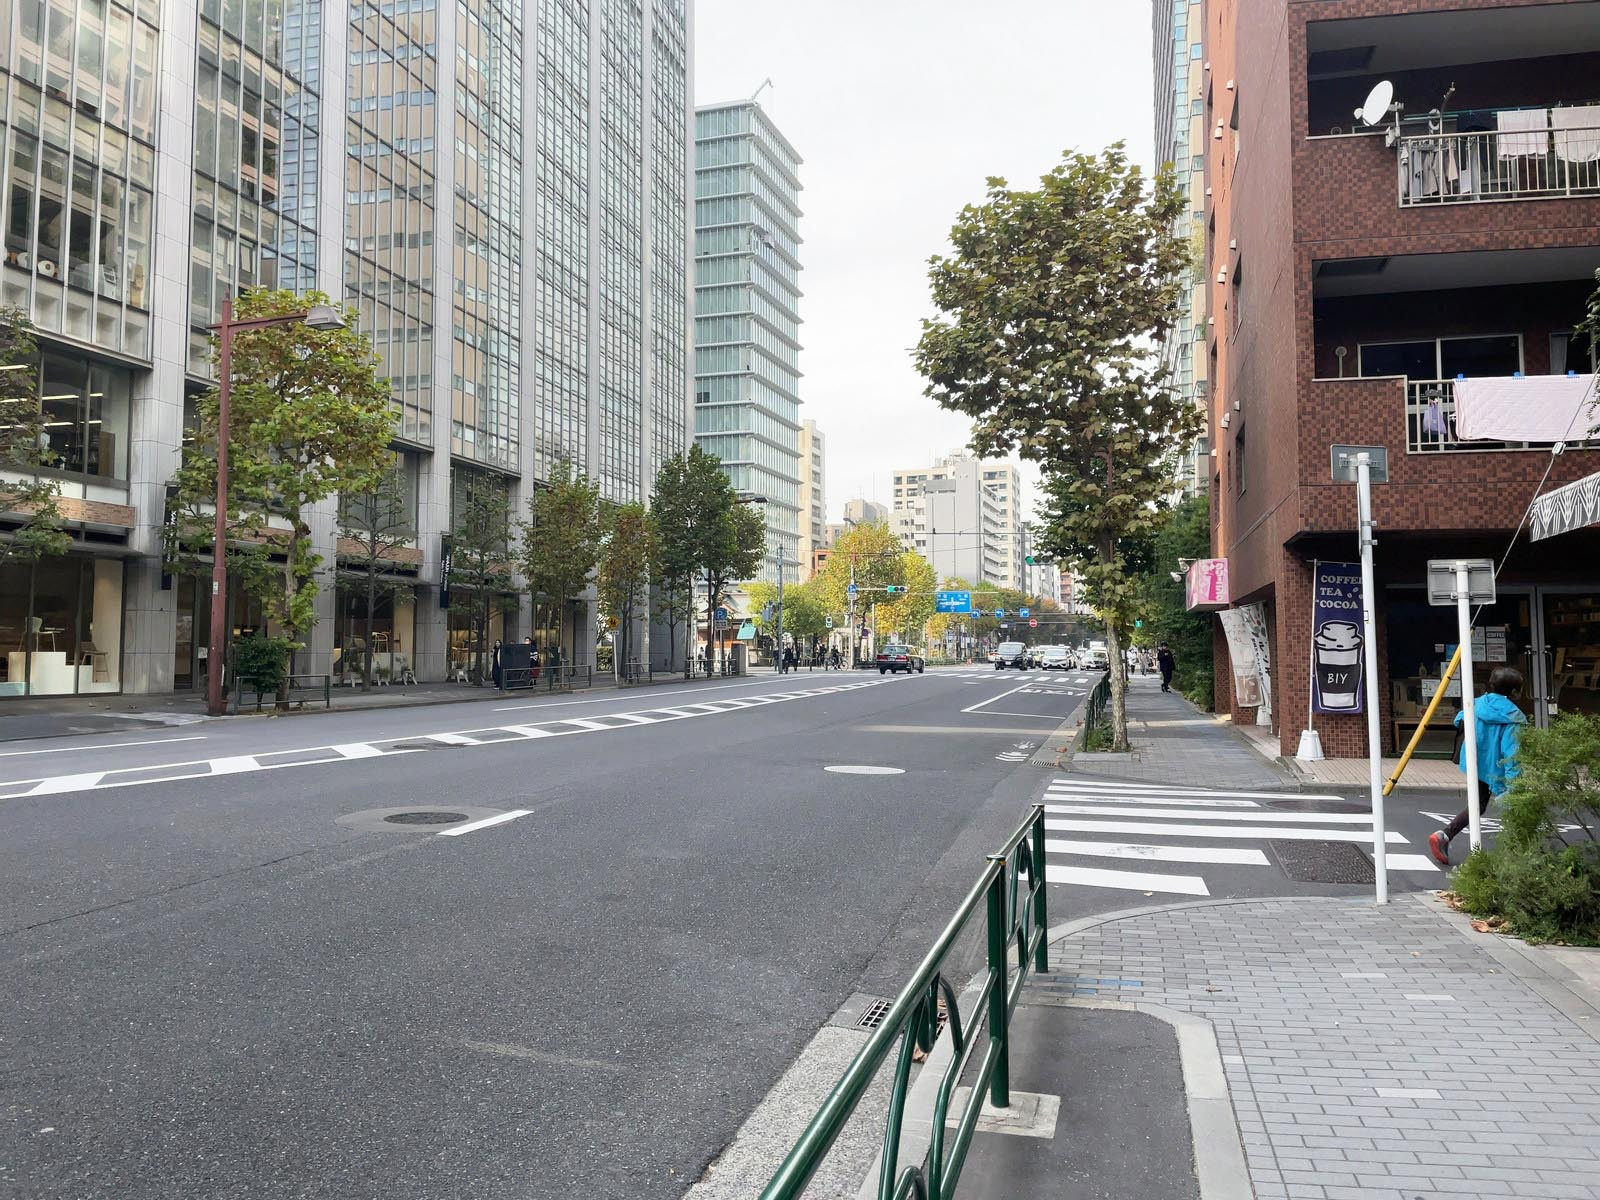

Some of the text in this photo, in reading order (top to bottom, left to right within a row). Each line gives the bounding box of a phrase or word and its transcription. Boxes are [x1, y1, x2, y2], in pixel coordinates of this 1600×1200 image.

[1320, 587, 1343, 596] TEA
[1319, 600, 1358, 609] COCOA
[1327, 673, 1348, 684] BIY
